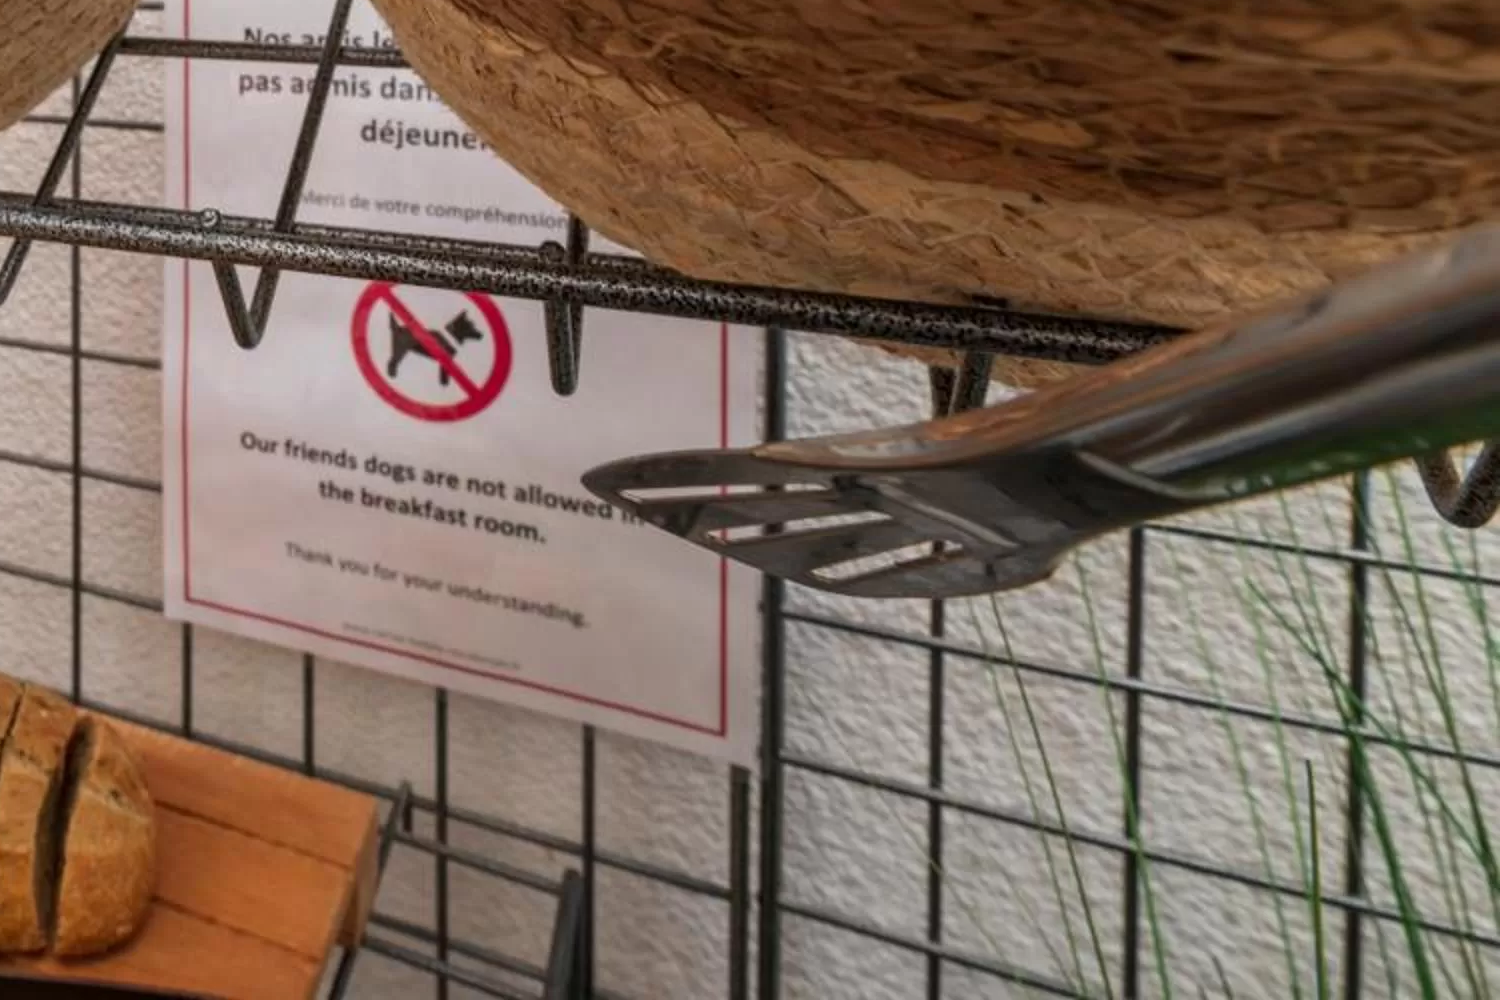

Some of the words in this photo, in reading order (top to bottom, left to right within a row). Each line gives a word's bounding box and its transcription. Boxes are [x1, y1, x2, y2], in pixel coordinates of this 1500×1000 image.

[239, 72, 282, 96] pas
[380, 75, 440, 102] dan
[350, 193, 370, 210] de
[375, 198, 421, 216] votre
[240, 431, 278, 454] Our
[284, 438, 357, 471] friends
[364, 455, 415, 483] dogs
[422, 468, 460, 490] are
[467, 477, 506, 499] not
[513, 484, 613, 520] allowed
[319, 480, 354, 503] the
[360, 487, 467, 529] breakfast
[474, 514, 547, 544] room.
[285, 541, 333, 567] Thank
[338, 556, 370, 577] you
[373, 562, 398, 581] for
[403, 572, 443, 592] your
[446, 582, 592, 629] understanding.
